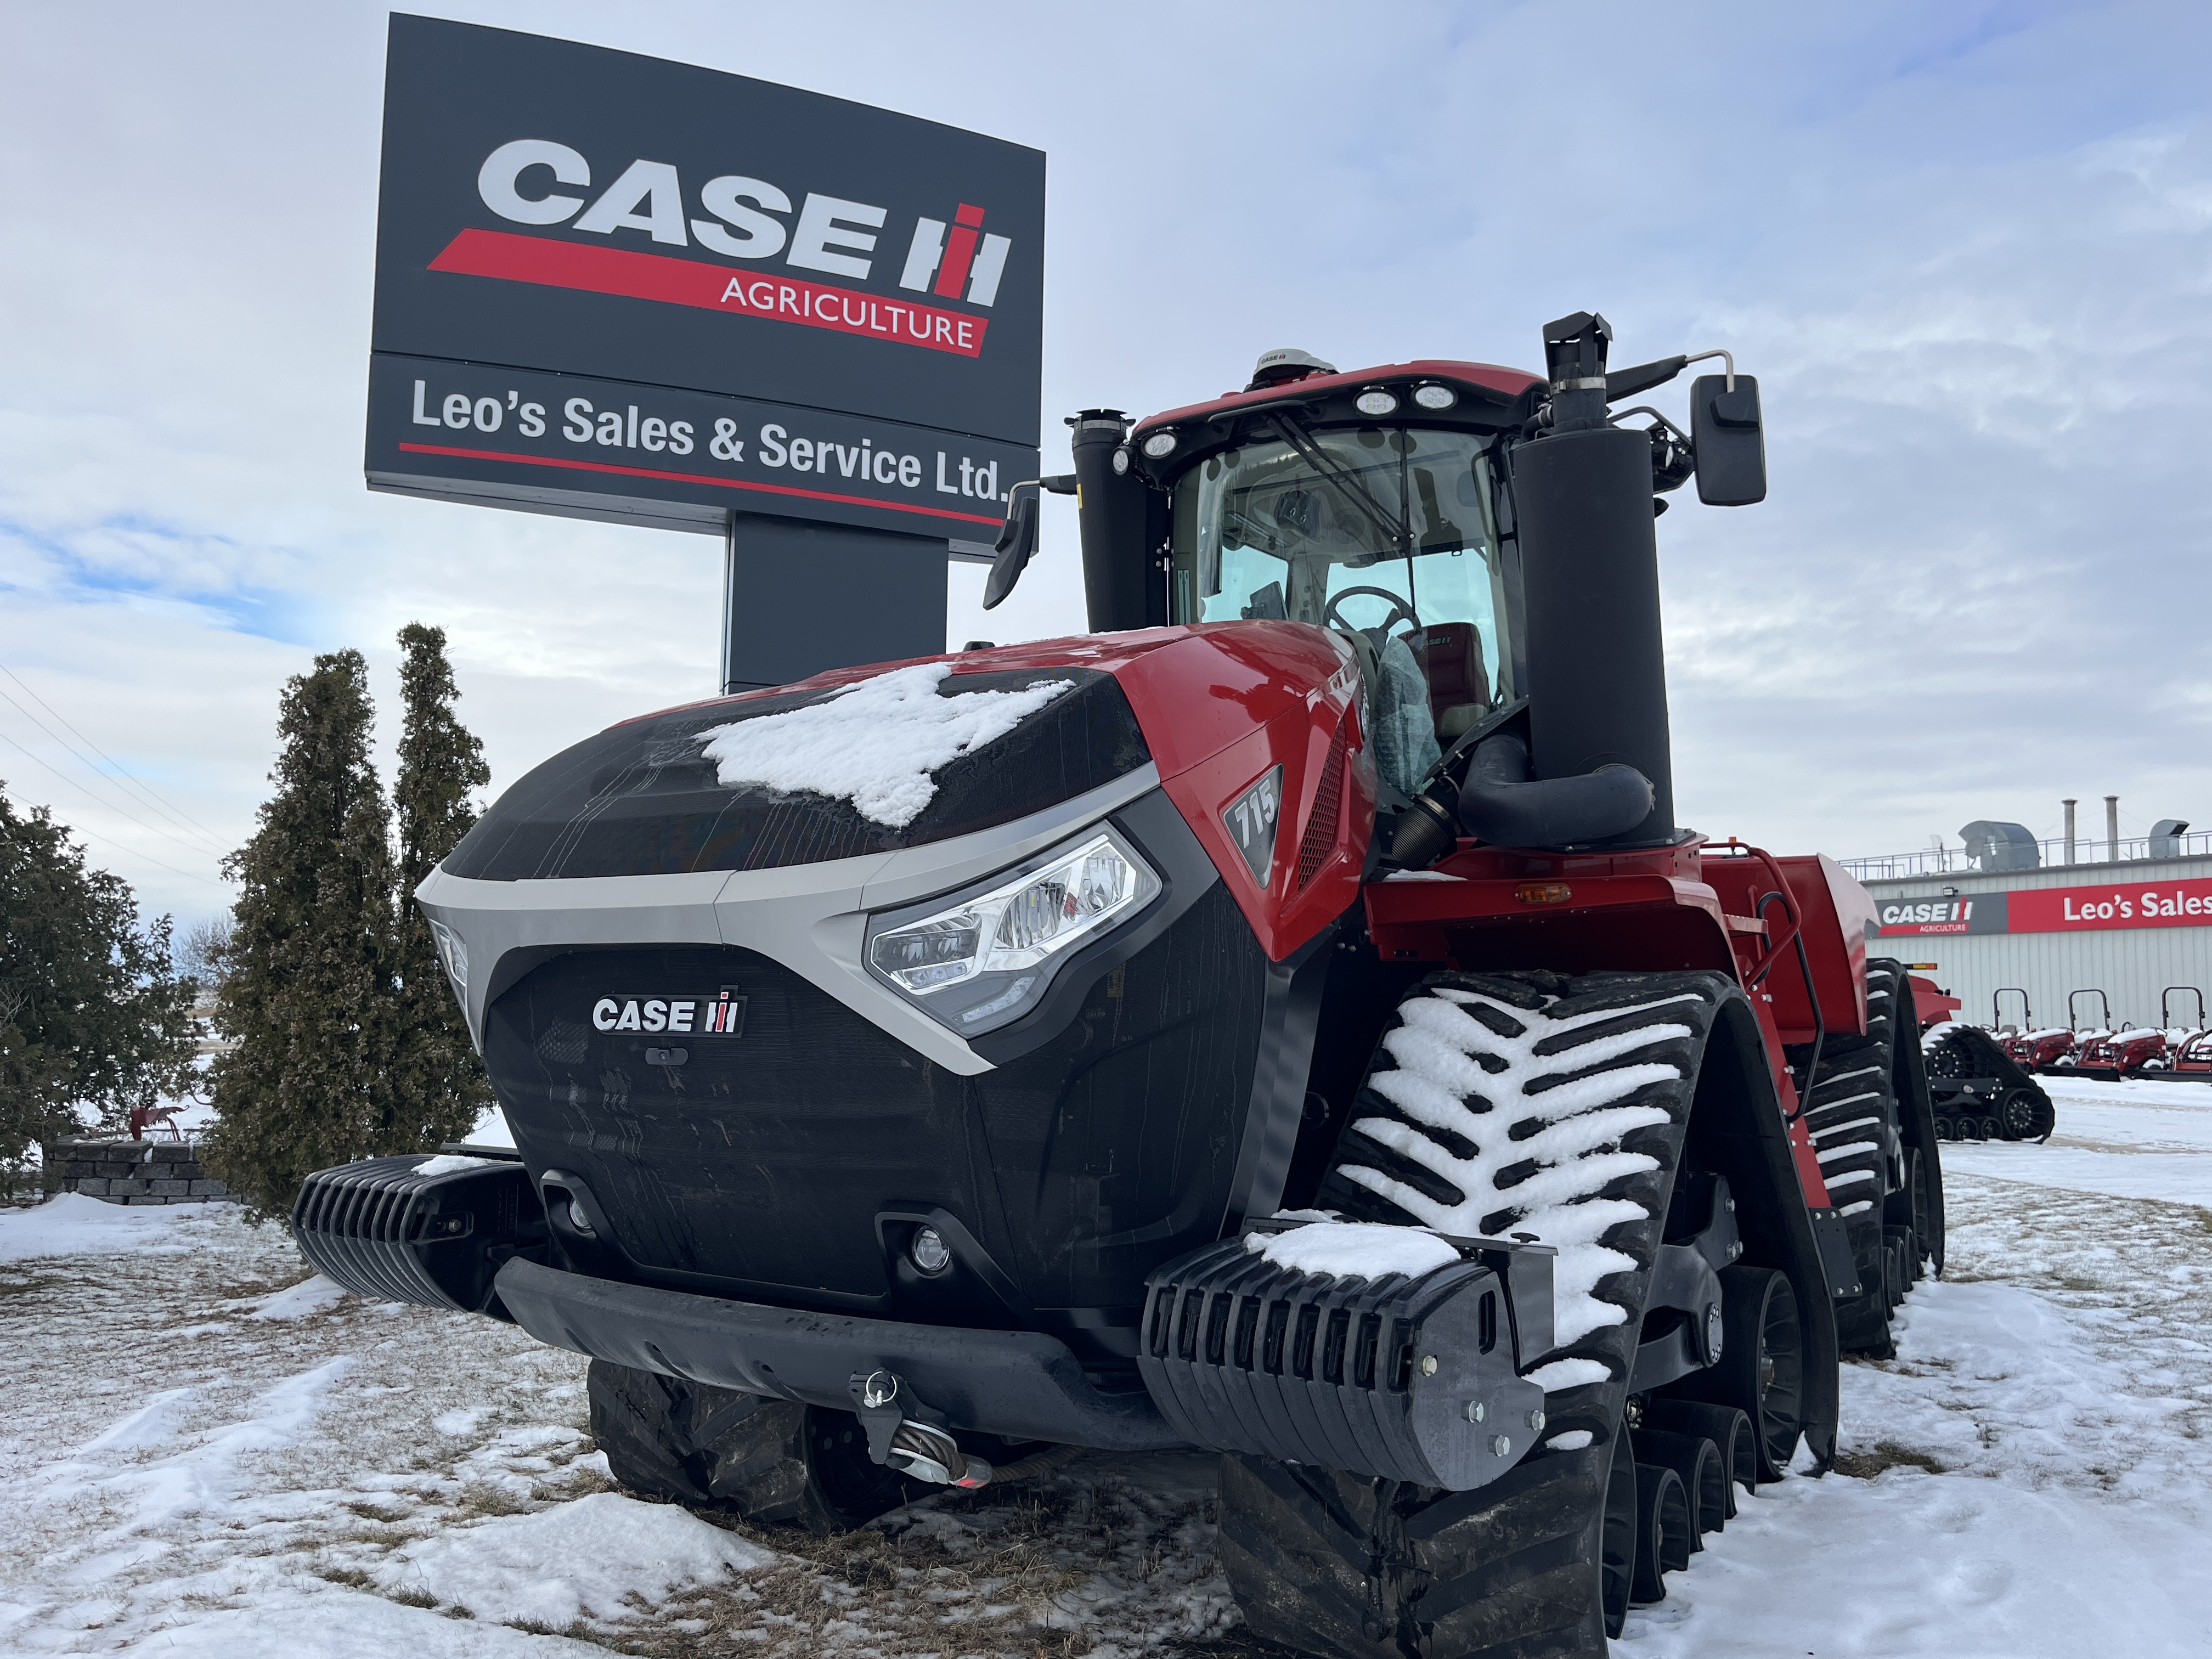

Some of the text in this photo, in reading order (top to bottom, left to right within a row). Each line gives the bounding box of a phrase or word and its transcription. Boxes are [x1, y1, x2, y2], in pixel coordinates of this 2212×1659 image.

[478, 139, 887, 280] CASE
[720, 277, 973, 348] AGRICULTURE
[1261, 356, 1278, 364] CASE
[412, 380, 1008, 502] Leo's Sales & Service Ltd.
[1234, 778, 1274, 849] 715
[1882, 903, 1948, 924] CASE
[2064, 890, 2212, 921] Leo's Sales
[1920, 924, 1966, 933] AGRICULTURE
[592, 998, 695, 1032] CASE
